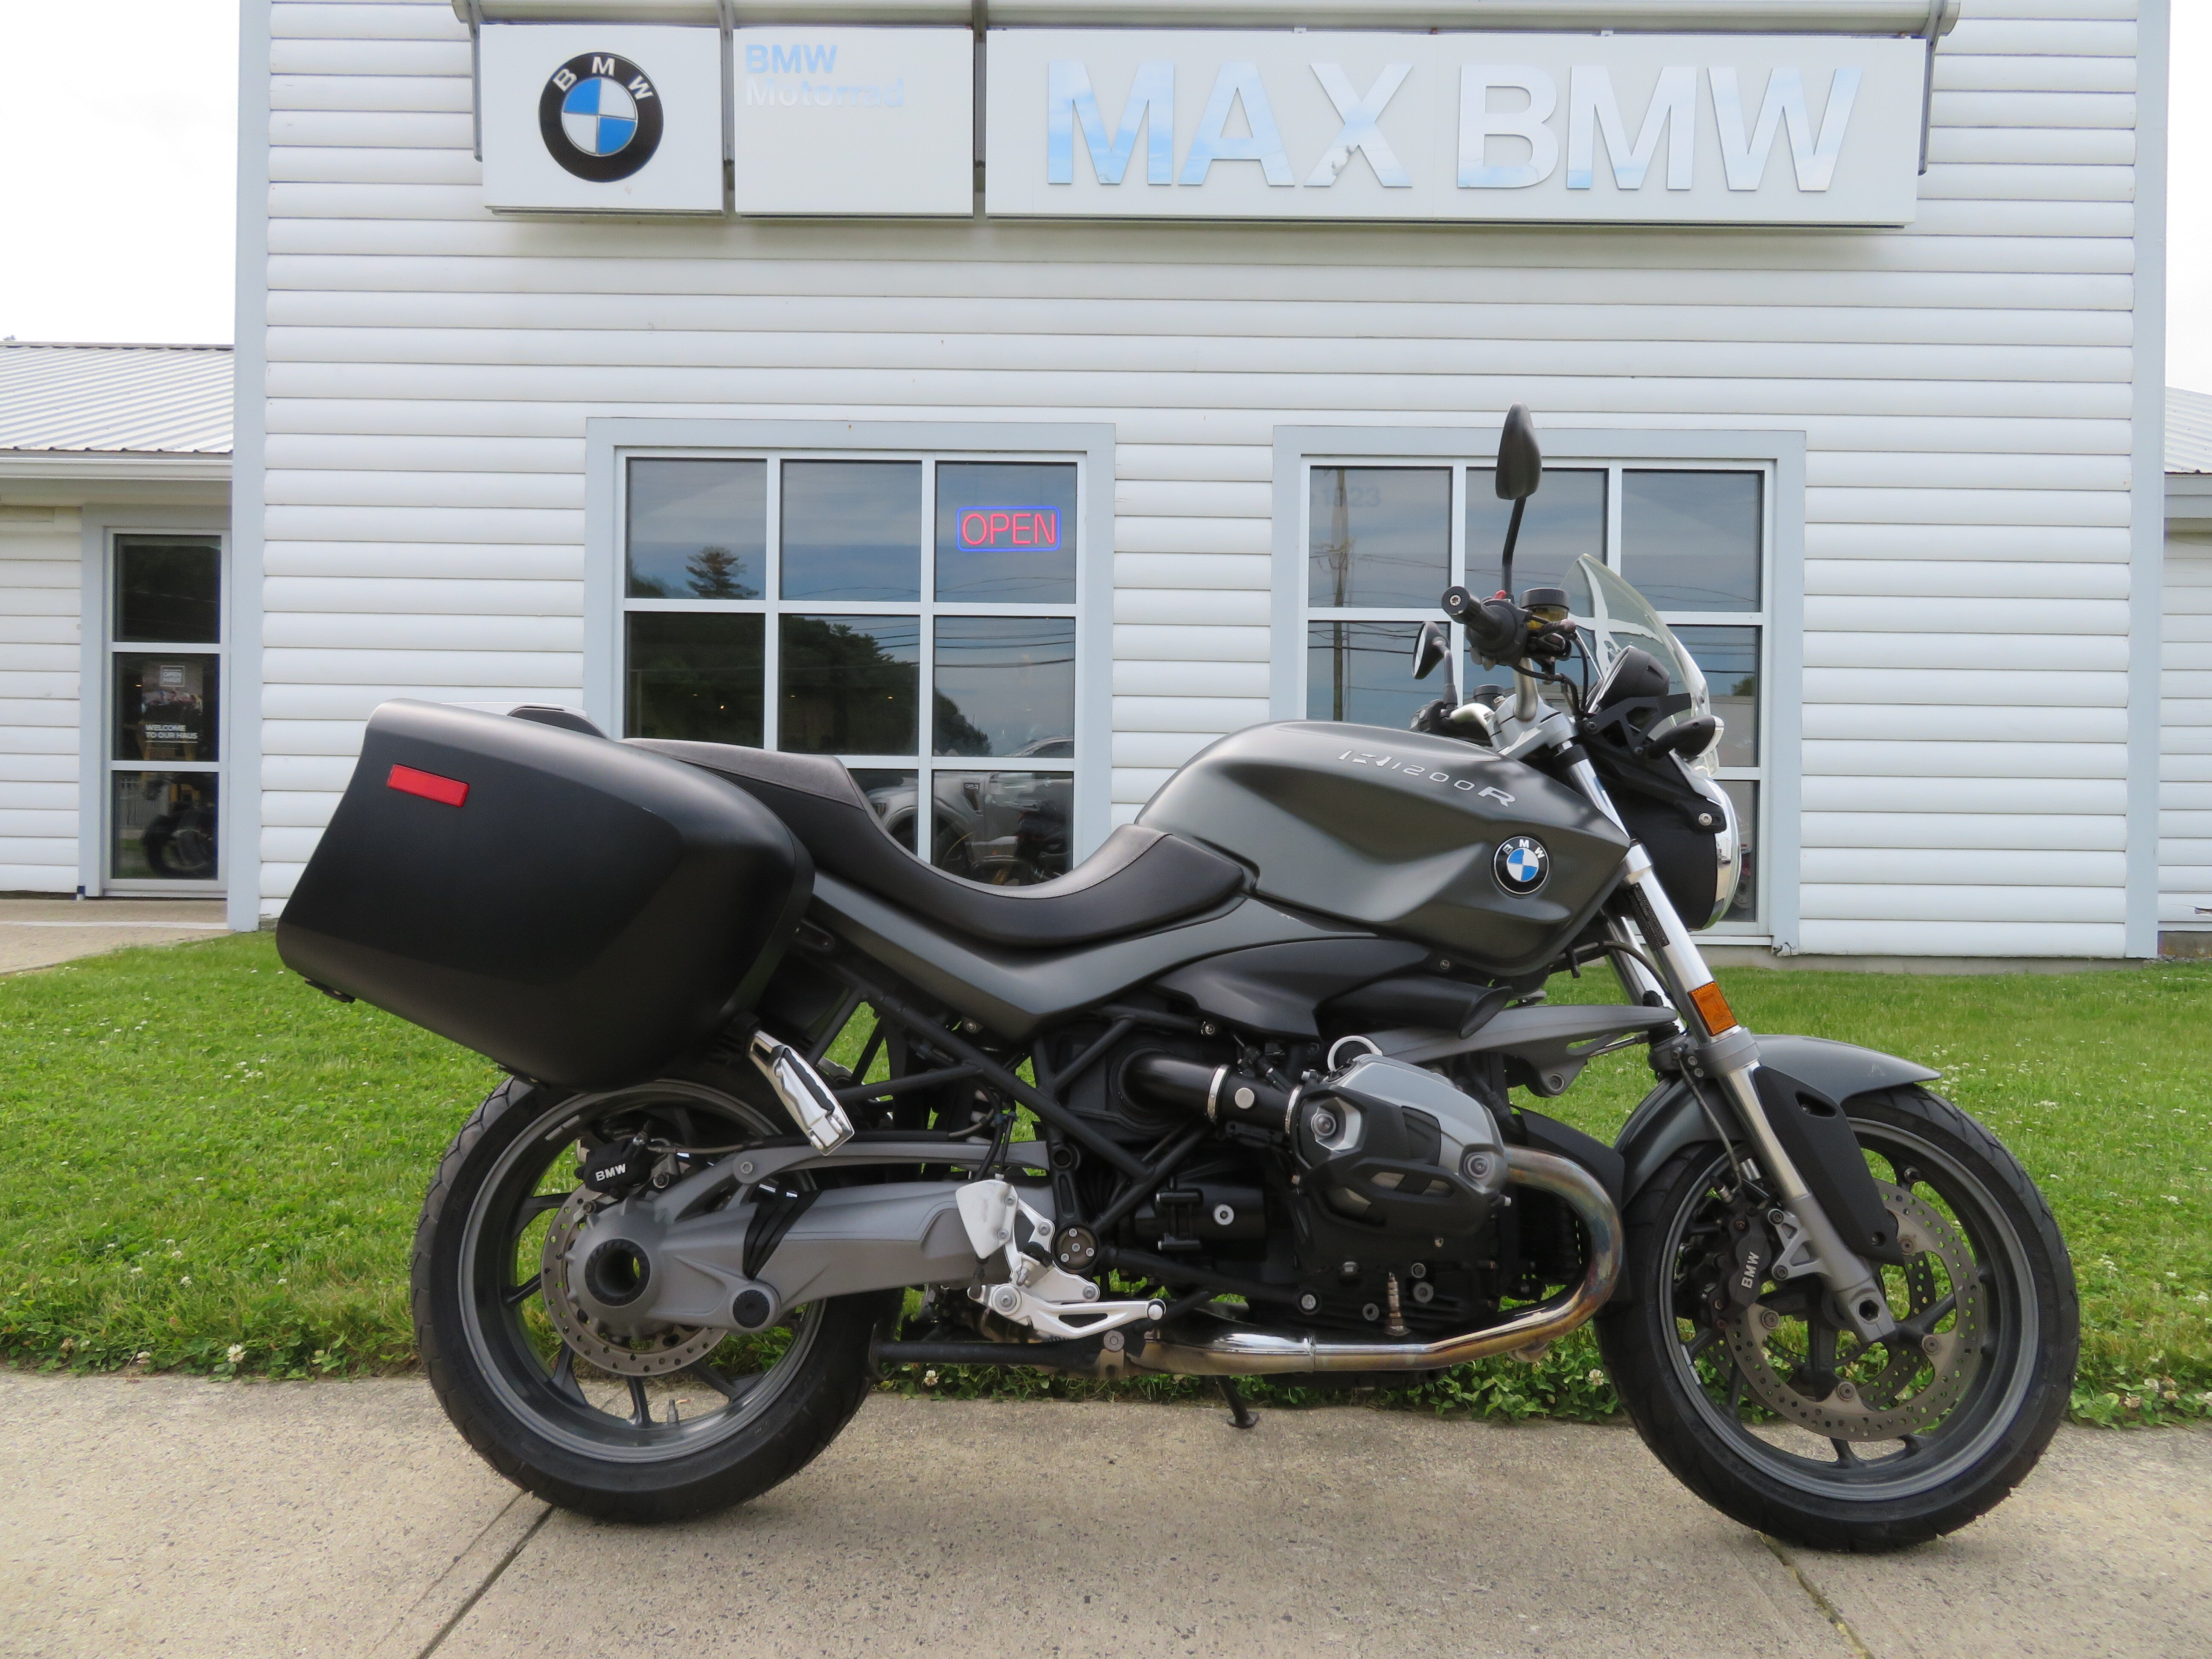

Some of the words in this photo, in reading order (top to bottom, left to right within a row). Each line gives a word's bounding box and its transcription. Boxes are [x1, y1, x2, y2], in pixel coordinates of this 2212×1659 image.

[745, 44, 838, 73] BMW
[553, 56, 655, 100] BMW
[746, 77, 904, 108] Motorrad
[1048, 60, 1414, 188] MAX
[1457, 64, 1863, 192] BMW
[962, 513, 1056, 545] OPEN
[1502, 838, 1545, 859] BMW
[595, 1163, 626, 1181] BMW
[1741, 1251, 1760, 1289] BMW
